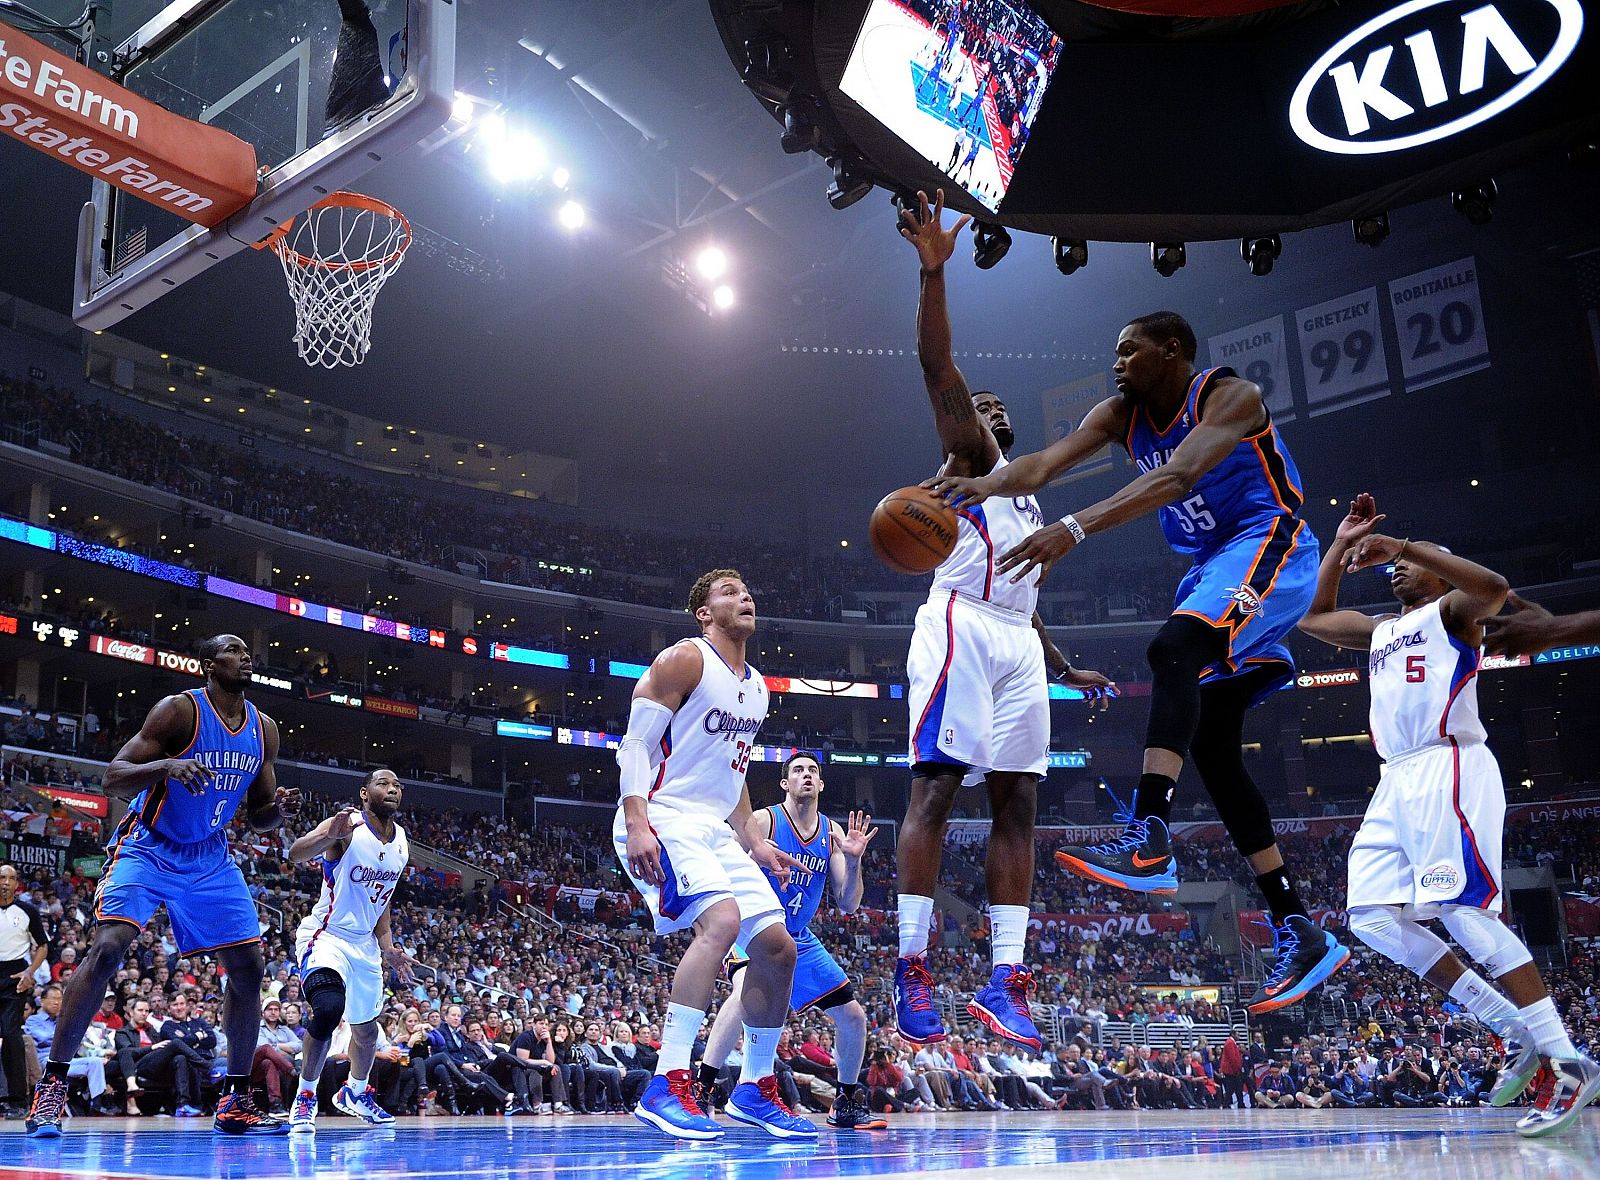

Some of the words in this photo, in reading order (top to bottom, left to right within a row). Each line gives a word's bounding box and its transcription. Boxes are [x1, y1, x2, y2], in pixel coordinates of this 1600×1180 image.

[1328, 4, 1537, 135] KIA
[34, 60, 139, 139] Farm
[0, 103, 110, 167] State
[99, 157, 214, 213] Farm
[1393, 270, 1475, 305] ROBITAILLE
[1304, 301, 1371, 332] GRETZKY
[1406, 301, 1475, 360] 20
[1220, 332, 1273, 358] TAYLOR
[1311, 329, 1373, 384] 99
[1166, 494, 1216, 533] 35
[1552, 645, 1600, 660] DELTA
[1314, 672, 1359, 684] TOYOTA
[1406, 656, 1425, 683] 5
[365, 700, 392, 712] WELLS
[392, 705, 418, 716] FARGO
[731, 740, 752, 774] 32
[215, 774, 242, 791] CITY
[211, 799, 228, 827] 9
[789, 870, 813, 887] CITY
[370, 883, 394, 906] 34
[788, 892, 803, 915] 4
